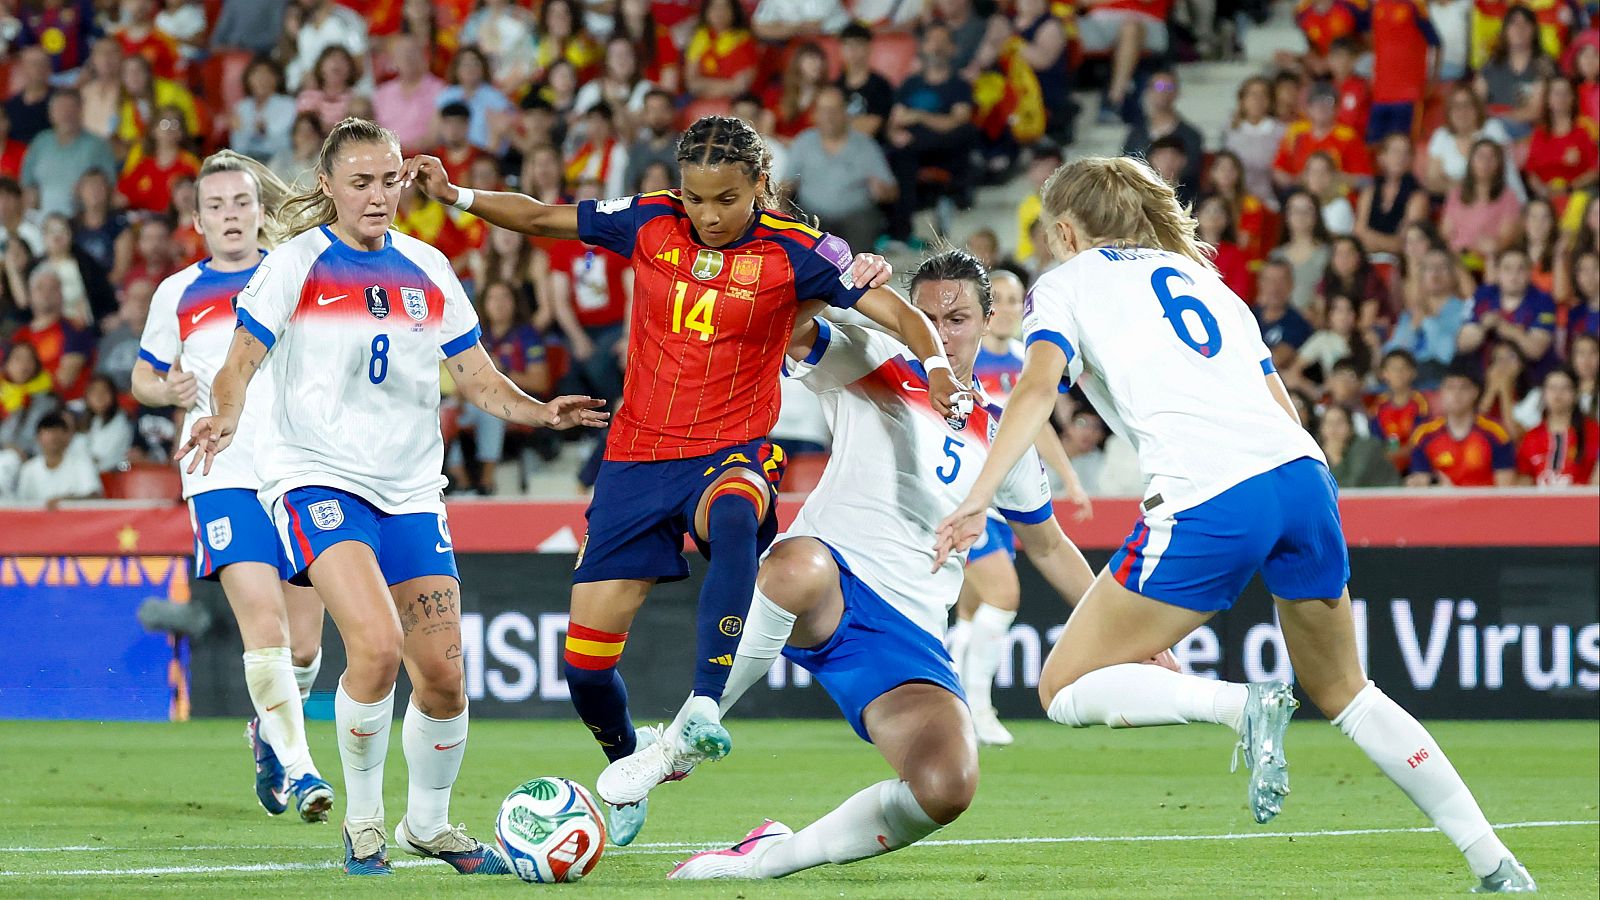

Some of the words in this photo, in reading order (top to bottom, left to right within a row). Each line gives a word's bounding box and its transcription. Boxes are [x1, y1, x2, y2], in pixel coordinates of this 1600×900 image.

[672, 281, 719, 341] 14
[1151, 267, 1222, 358] 6
[369, 334, 390, 384] 8
[936, 435, 965, 485] 5
[1243, 599, 1368, 684] dl
[1407, 748, 1429, 769] ENG
